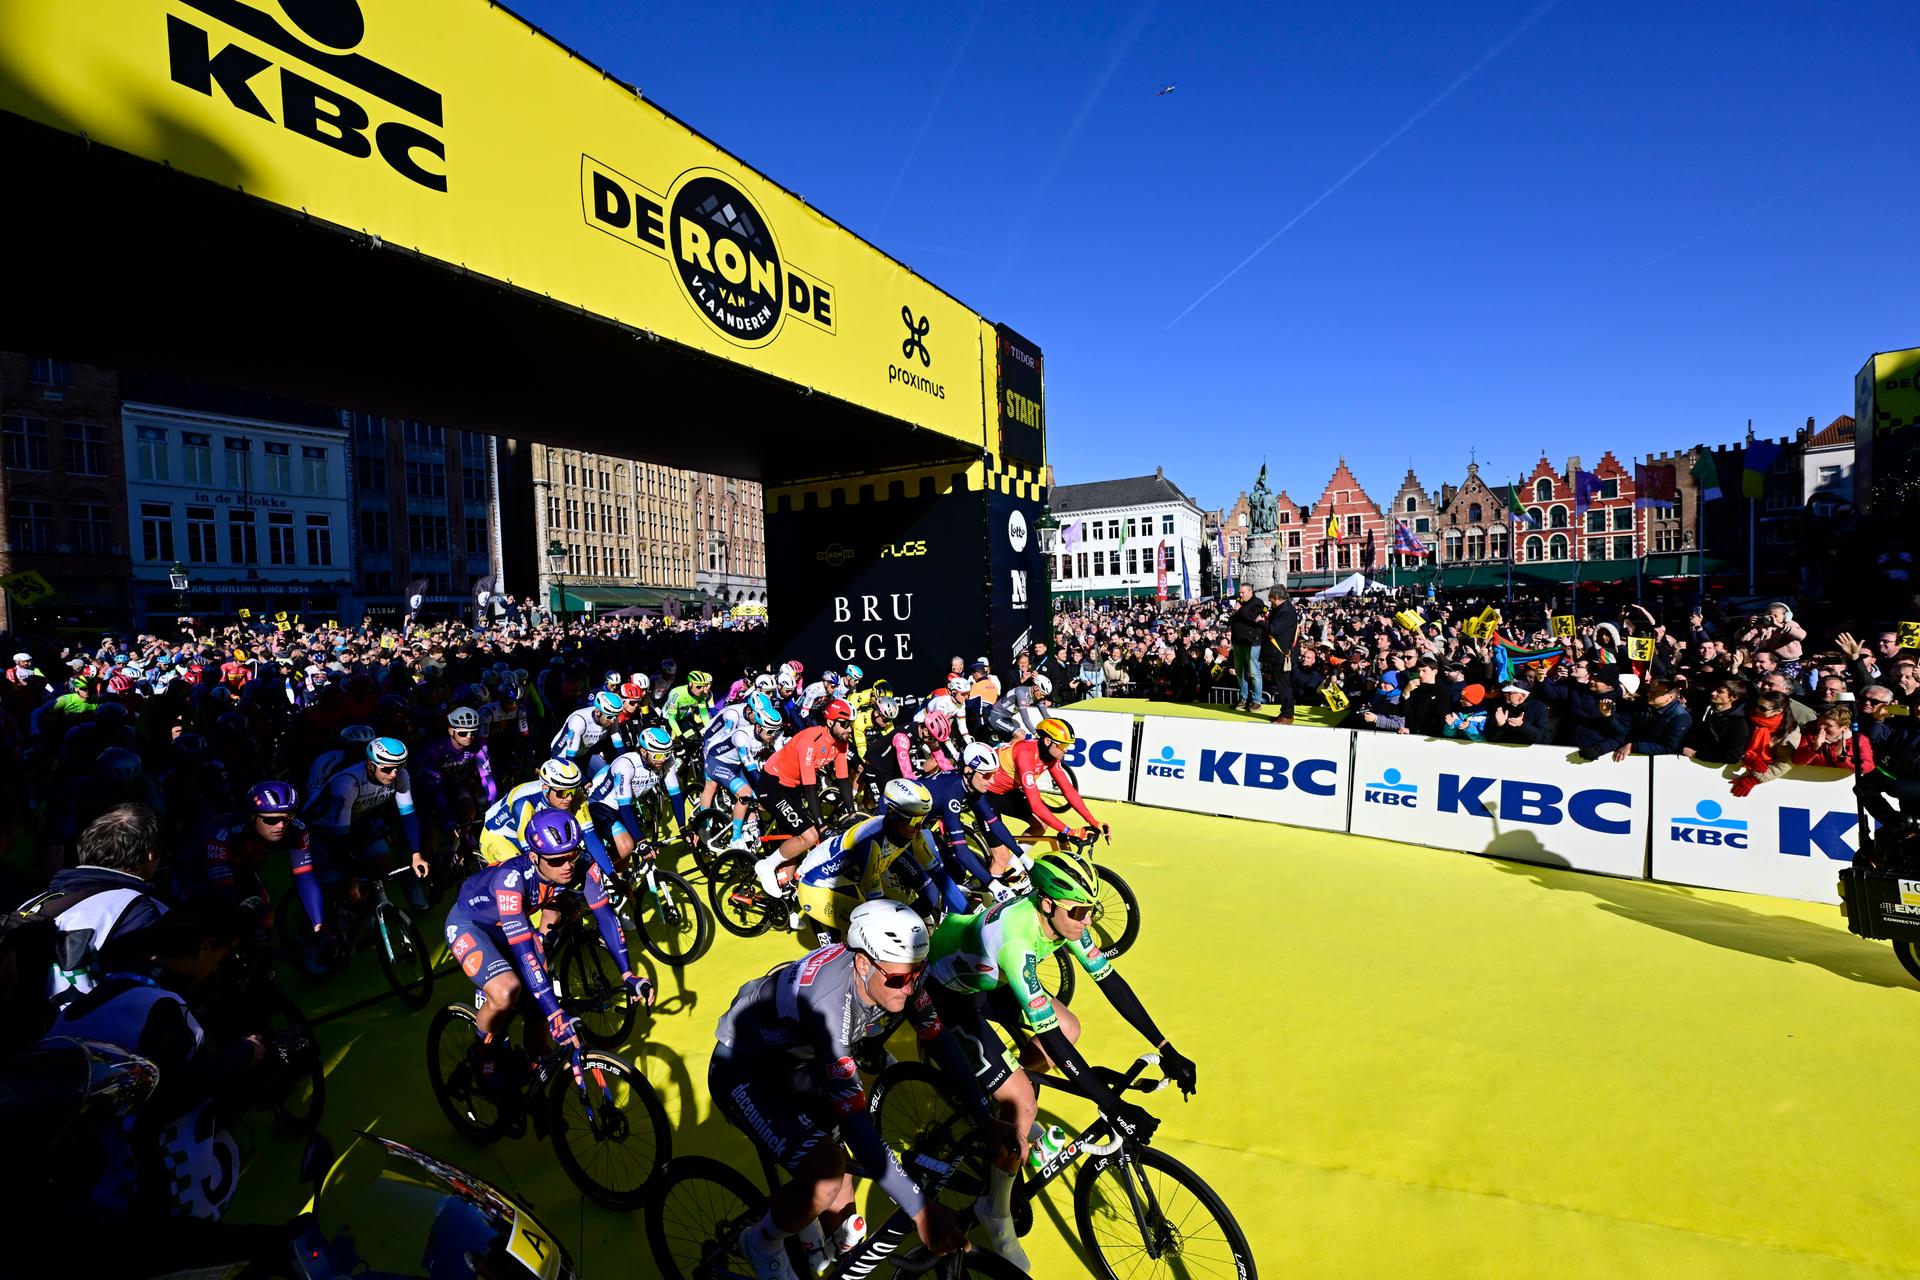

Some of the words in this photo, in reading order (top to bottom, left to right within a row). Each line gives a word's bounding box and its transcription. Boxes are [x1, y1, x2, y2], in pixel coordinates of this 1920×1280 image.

[166, 13, 447, 193] KBC
[593, 171, 666, 249] DE
[788, 271, 831, 326] DE
[691, 275, 771, 331] VLAANDEREN
[719, 287, 745, 308] VAN
[1010, 345, 1035, 369] TUDOR
[888, 363, 945, 400] proximus
[1005, 388, 1040, 430] START
[215, 493, 231, 504] de
[236, 495, 287, 508] Klokke
[186, 585, 212, 594] LAME
[216, 585, 257, 594] GRILLING
[260, 585, 285, 594] SINCE
[288, 585, 310, 594] 1954
[833, 592, 913, 623] BRU
[835, 633, 913, 661] GGE
[1062, 737, 1123, 772] BC
[1146, 764, 1185, 780] KBC
[1199, 749, 1338, 797] KBC
[775, 799, 804, 828] INEOS
[1364, 790, 1418, 808] KBC
[1437, 773, 1632, 835] KBC
[1670, 826, 1748, 849] KBC
[499, 895, 518, 903] PIC
[839, 992, 853, 1046] deceuninck
[730, 1082, 787, 1158] deceuninck
[1042, 1159, 1060, 1179] DE
[522, 1227, 546, 1261] A
